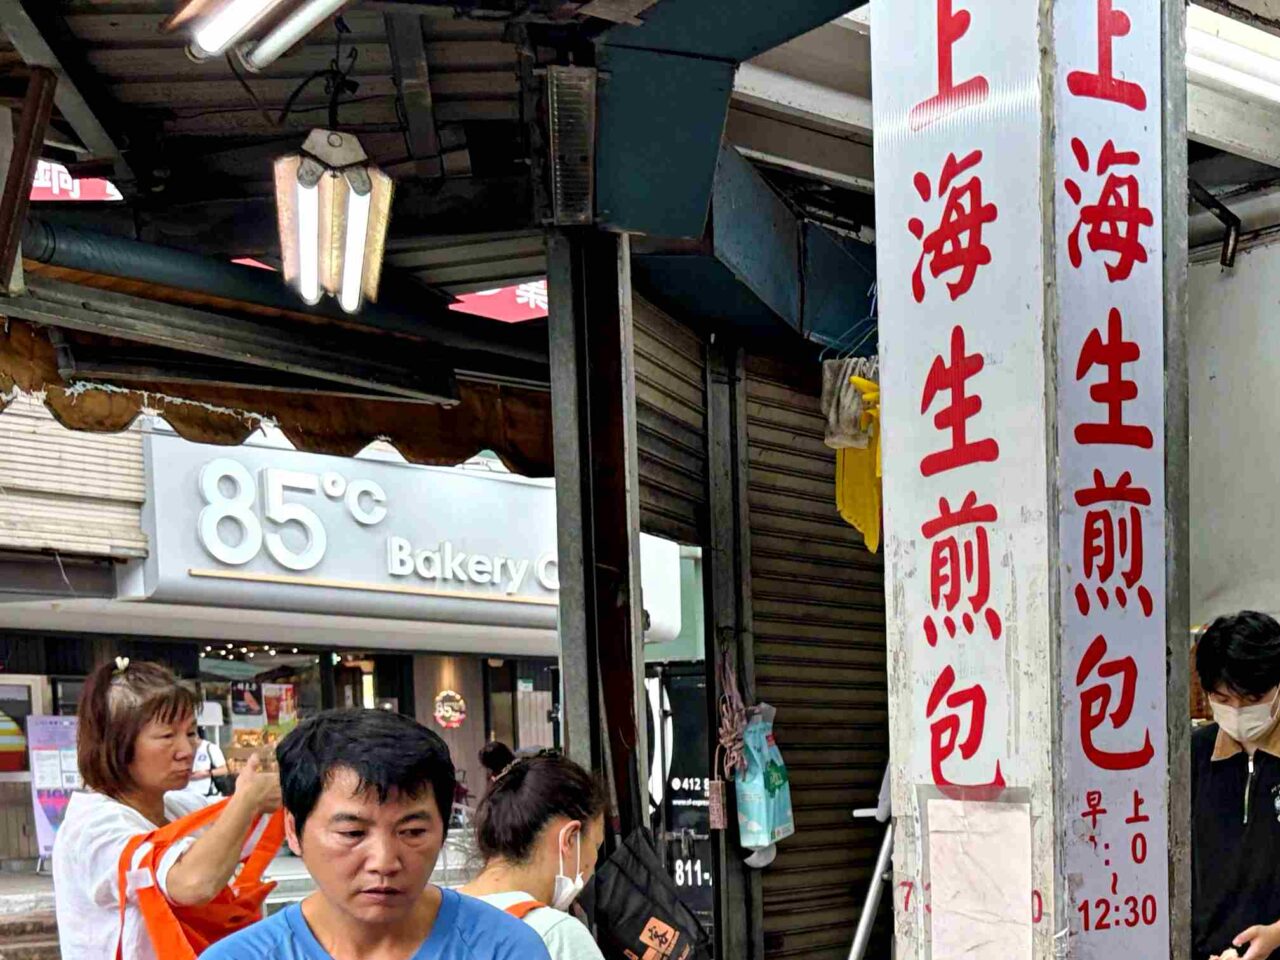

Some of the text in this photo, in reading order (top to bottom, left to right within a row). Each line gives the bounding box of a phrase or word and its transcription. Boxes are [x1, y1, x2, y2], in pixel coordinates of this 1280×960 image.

[386, 535, 530, 595] Bakery
[908, 0, 1006, 800] 上海生煎包
[1064, 0, 1155, 770] 上海生煎包
[1078, 894, 1157, 931] 12:30
